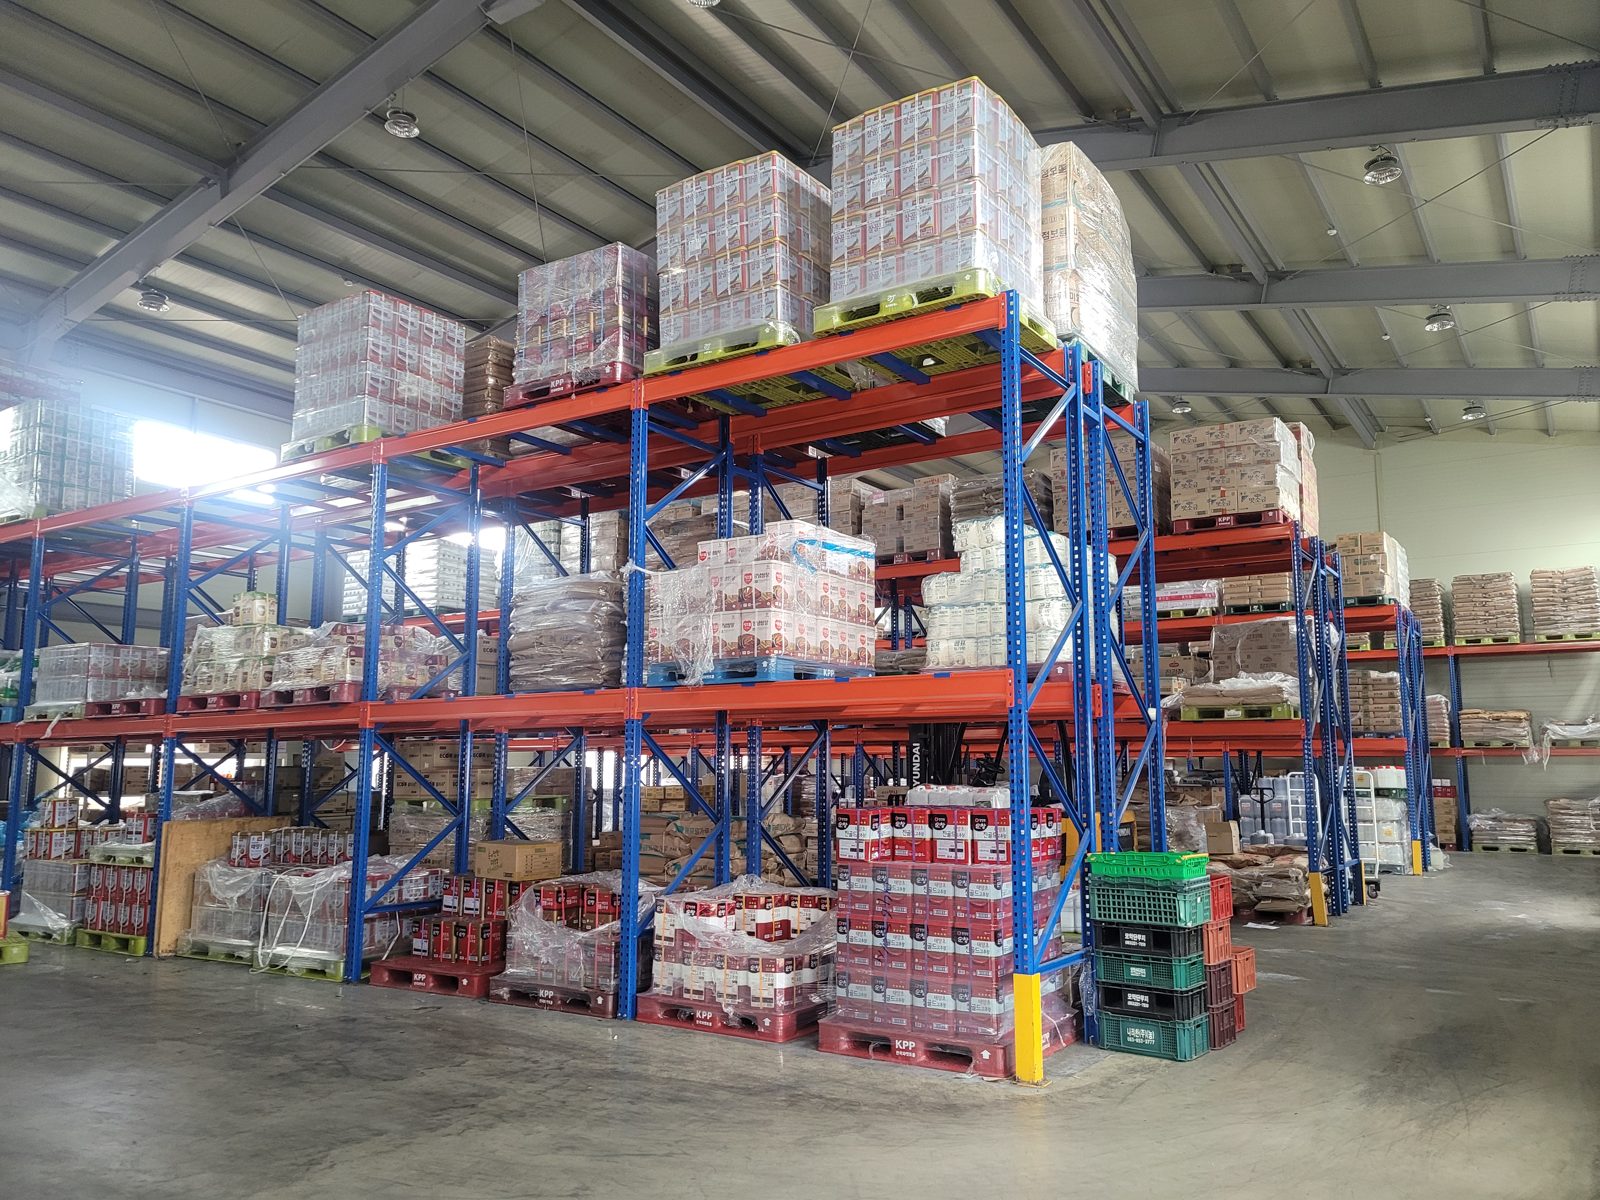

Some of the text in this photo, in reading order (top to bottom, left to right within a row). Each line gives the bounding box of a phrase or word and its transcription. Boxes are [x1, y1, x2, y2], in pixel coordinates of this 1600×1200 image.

[550, 378, 564, 388] KPP
[539, 989, 554, 998] KPP
[696, 1010, 713, 1020] KPP
[896, 1040, 915, 1050] KPP
